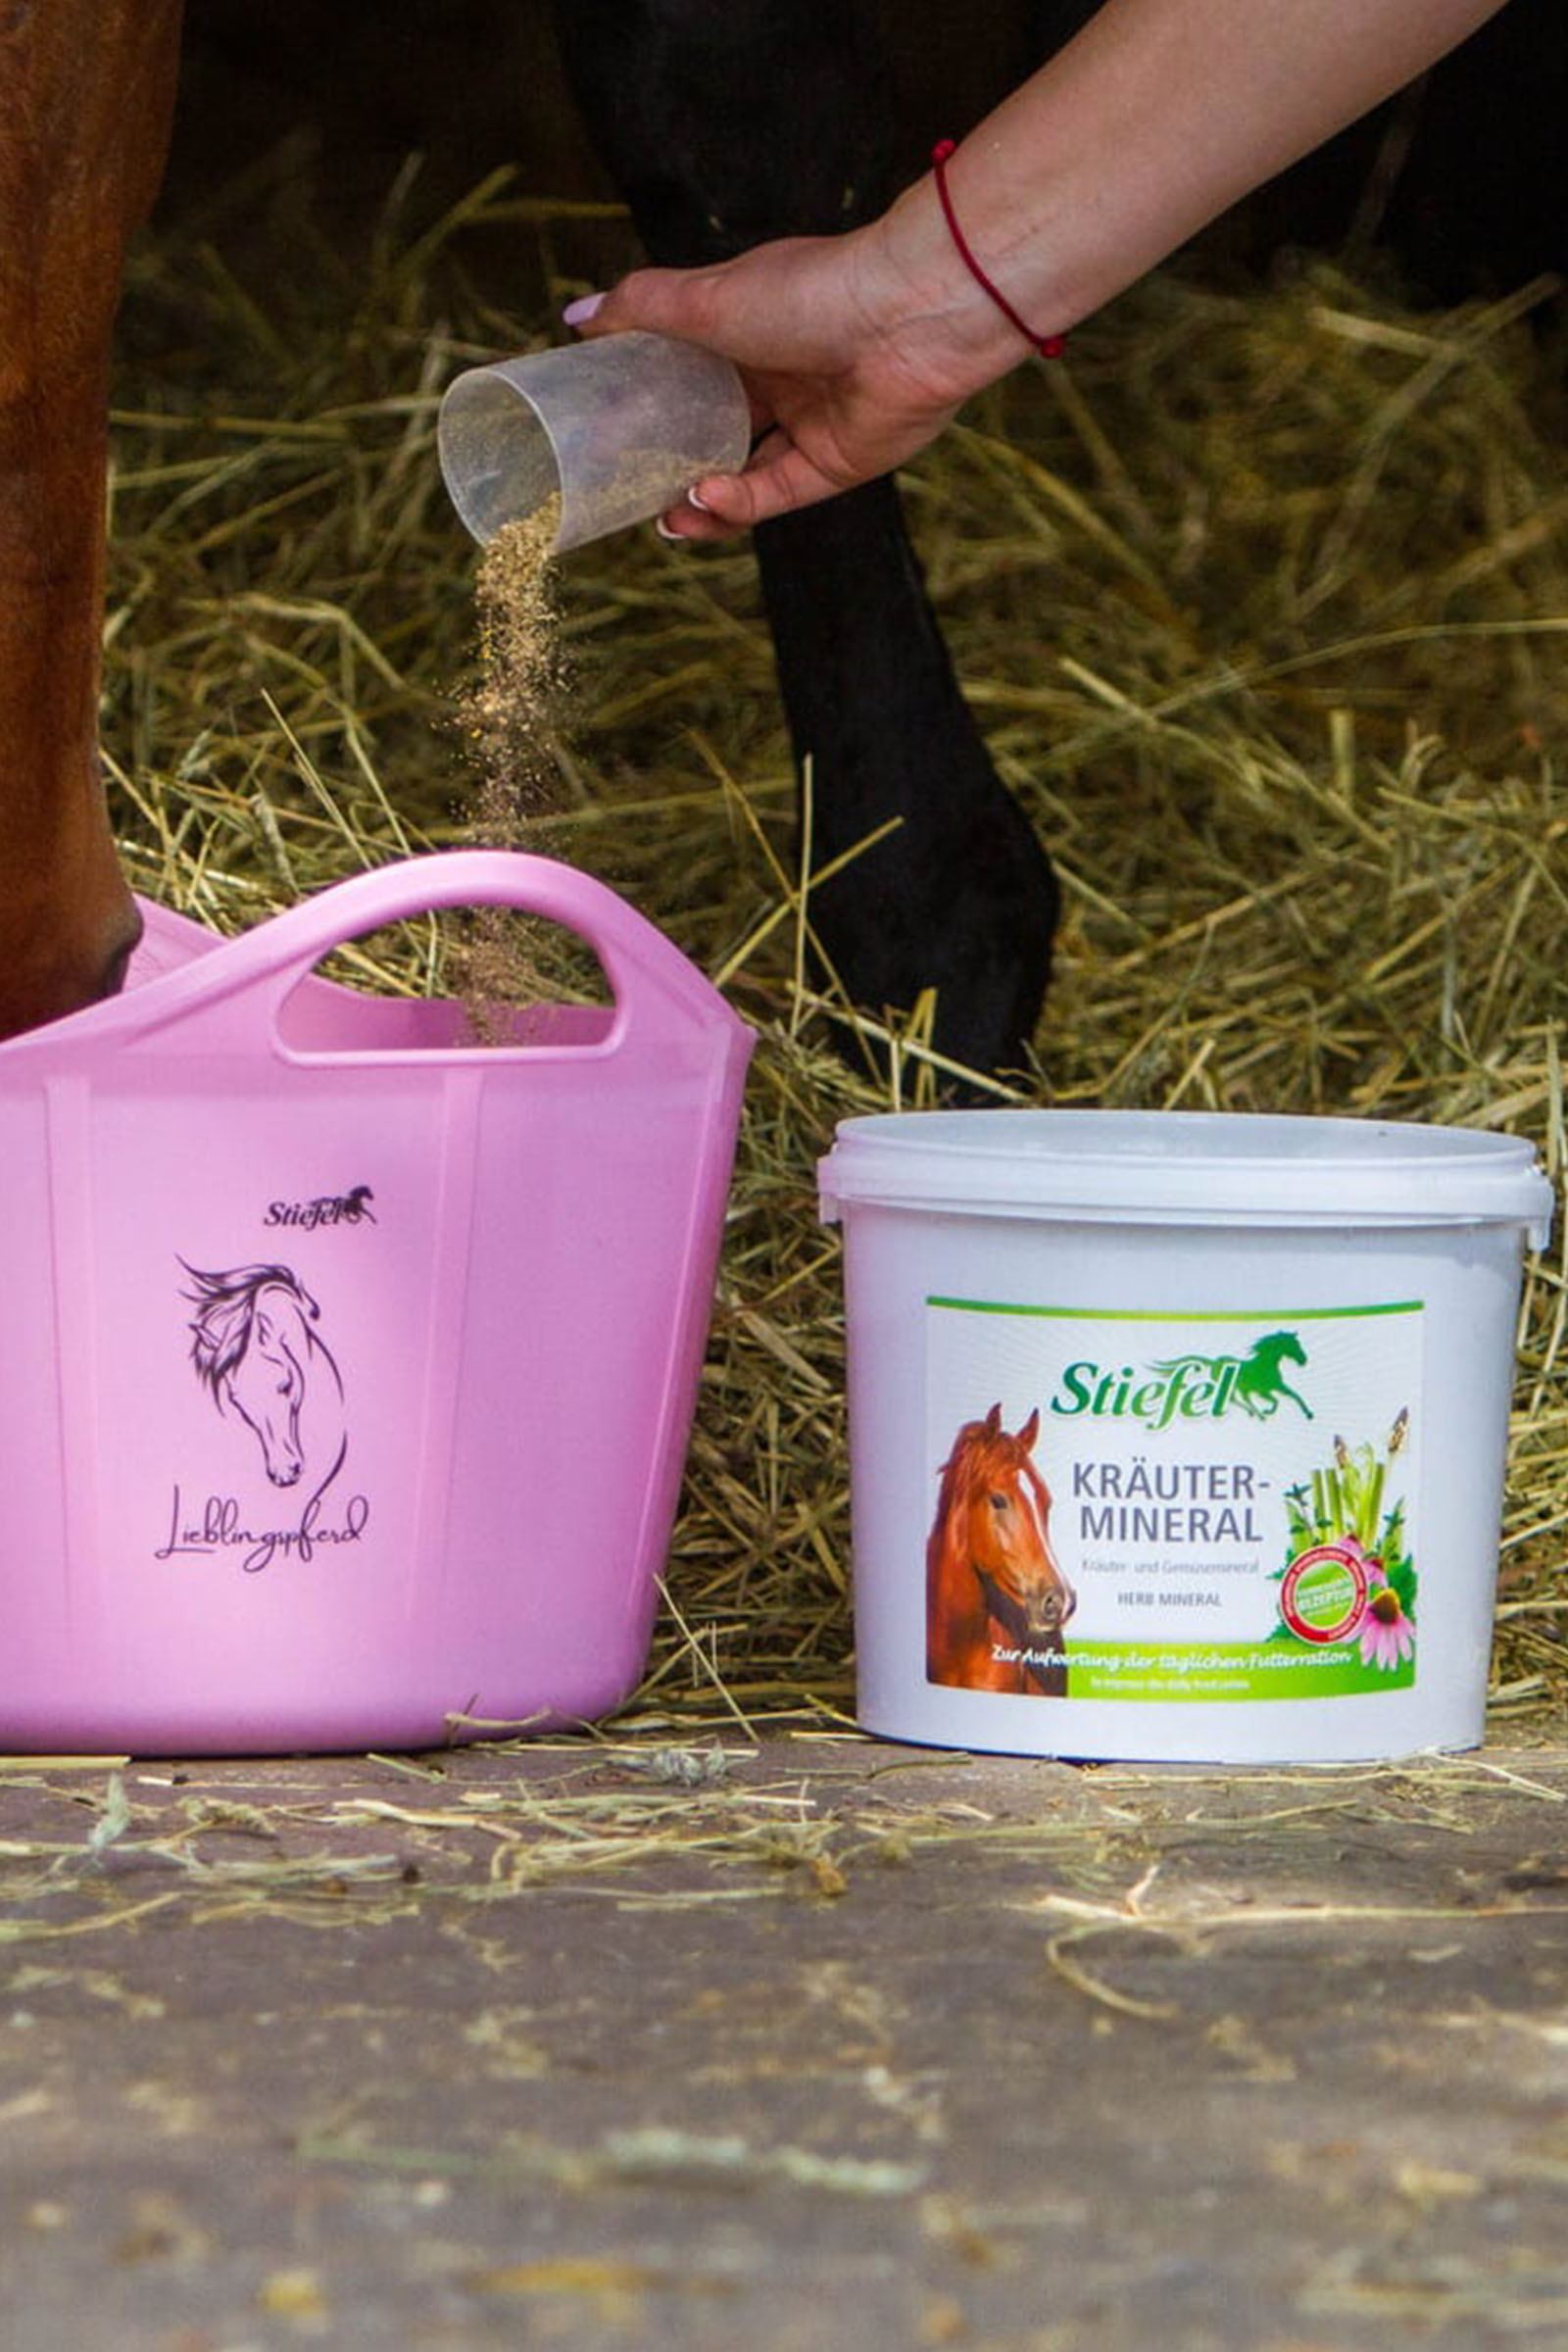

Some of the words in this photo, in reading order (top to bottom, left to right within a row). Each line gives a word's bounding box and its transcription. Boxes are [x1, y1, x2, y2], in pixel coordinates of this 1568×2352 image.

[264, 1201, 345, 1231] Stiefel
[1051, 1359, 1242, 1431] Stiefel
[1072, 1456, 1271, 1501] KRÄUTER-
[155, 1483, 368, 1573] Lieblingspferd
[1080, 1506, 1263, 1544] MINERAL
[1134, 1559, 1158, 1574] und
[1117, 1592, 1154, 1605] HERB
[1158, 1592, 1222, 1607] MINERAL
[992, 1643, 1021, 1662] Zur
[1022, 1646, 1121, 1674] Aufwertung
[1126, 1650, 1154, 1668] der
[1157, 1651, 1246, 1675] täglichen
[1247, 1649, 1353, 1671] Futterration
